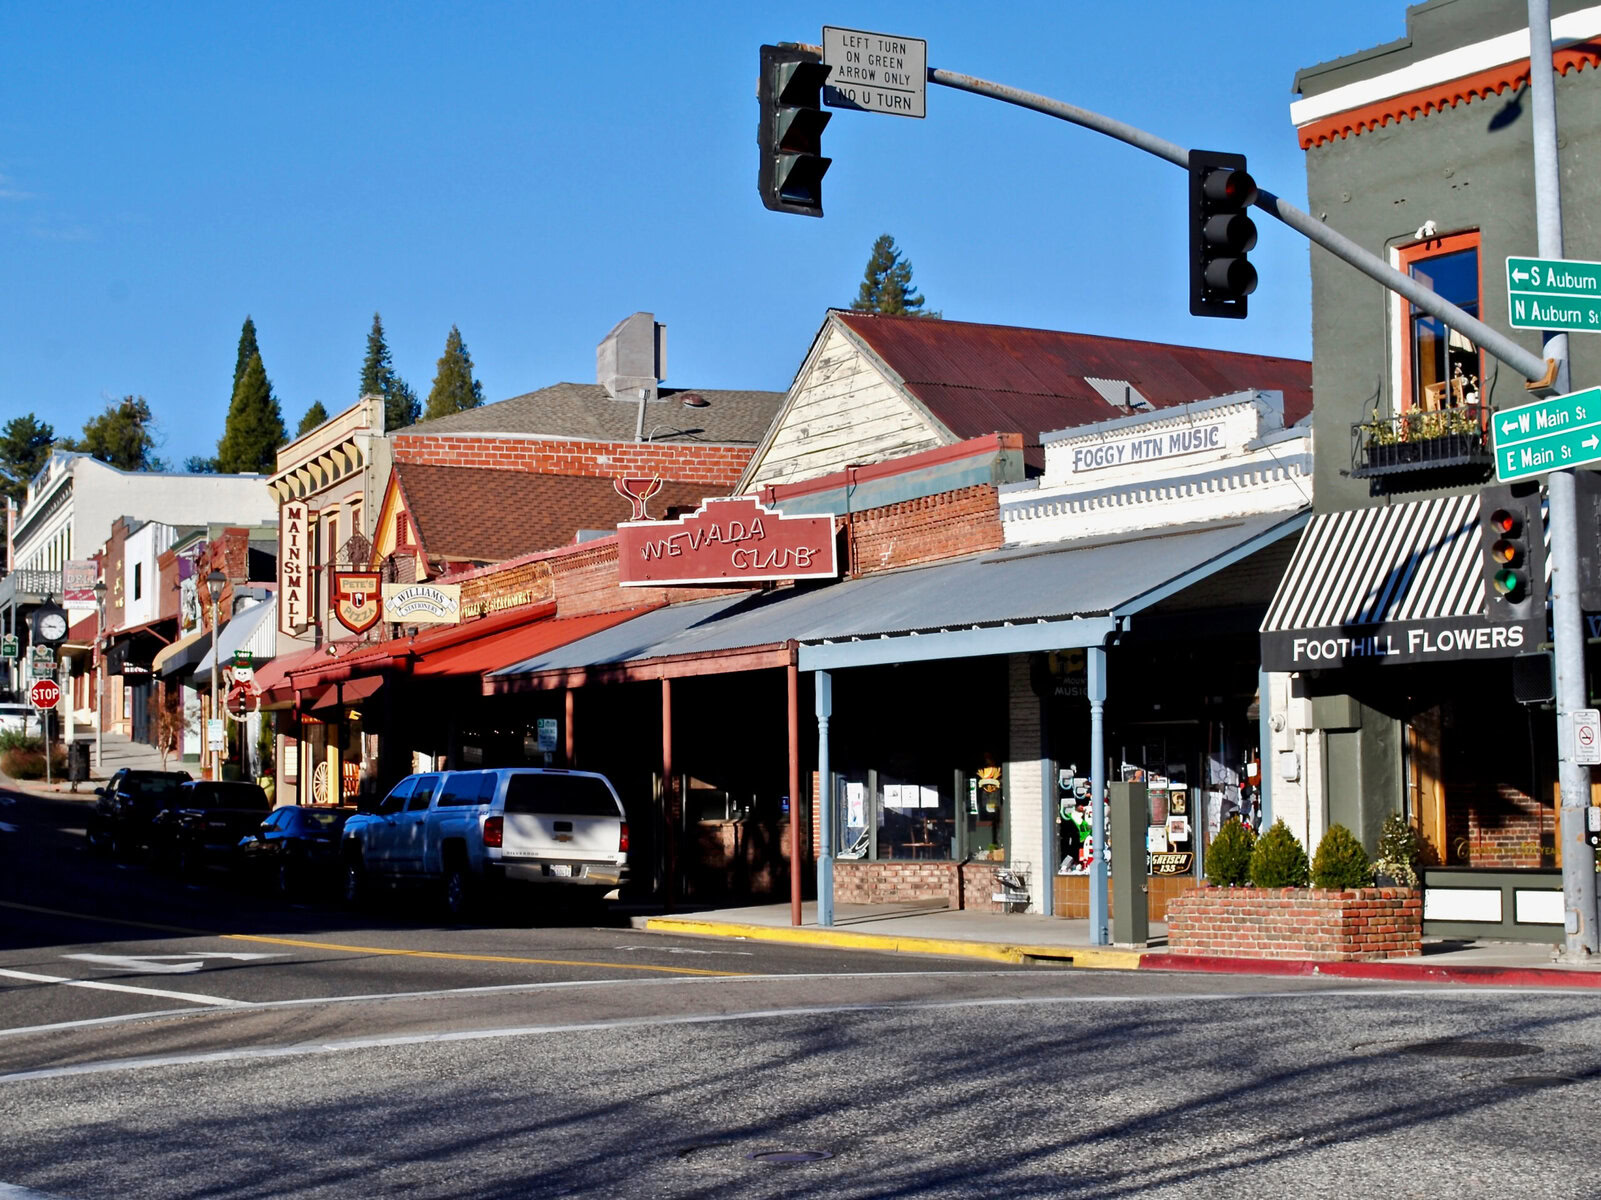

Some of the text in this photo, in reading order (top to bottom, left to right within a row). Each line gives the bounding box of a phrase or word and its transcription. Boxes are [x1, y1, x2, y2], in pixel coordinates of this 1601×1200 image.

[843, 35, 906, 55] LEFT TURN
[846, 51, 903, 70] ON GREEN
[839, 65, 911, 86] ARROW ONLY
[838, 88, 911, 110] NO U TURN
[1530, 266, 1597, 290] S Auburn
[1515, 300, 1599, 324] N Auburn St
[1518, 405, 1587, 434] W Main St
[1074, 426, 1219, 471] FOGGY MTN MUSIC
[1506, 445, 1572, 472] E Main St
[288, 507, 301, 560] MAIN
[731, 547, 814, 569] CLUB
[342, 579, 375, 588] PETE'S
[397, 586, 445, 603] WILLIAMS
[287, 575, 301, 629] MALL
[404, 603, 439, 614] STATIONERY
[343, 606, 376, 622] PIZZA
[1292, 625, 1524, 662] FOOTHILL FLOWERS
[32, 688, 59, 701] STOP
